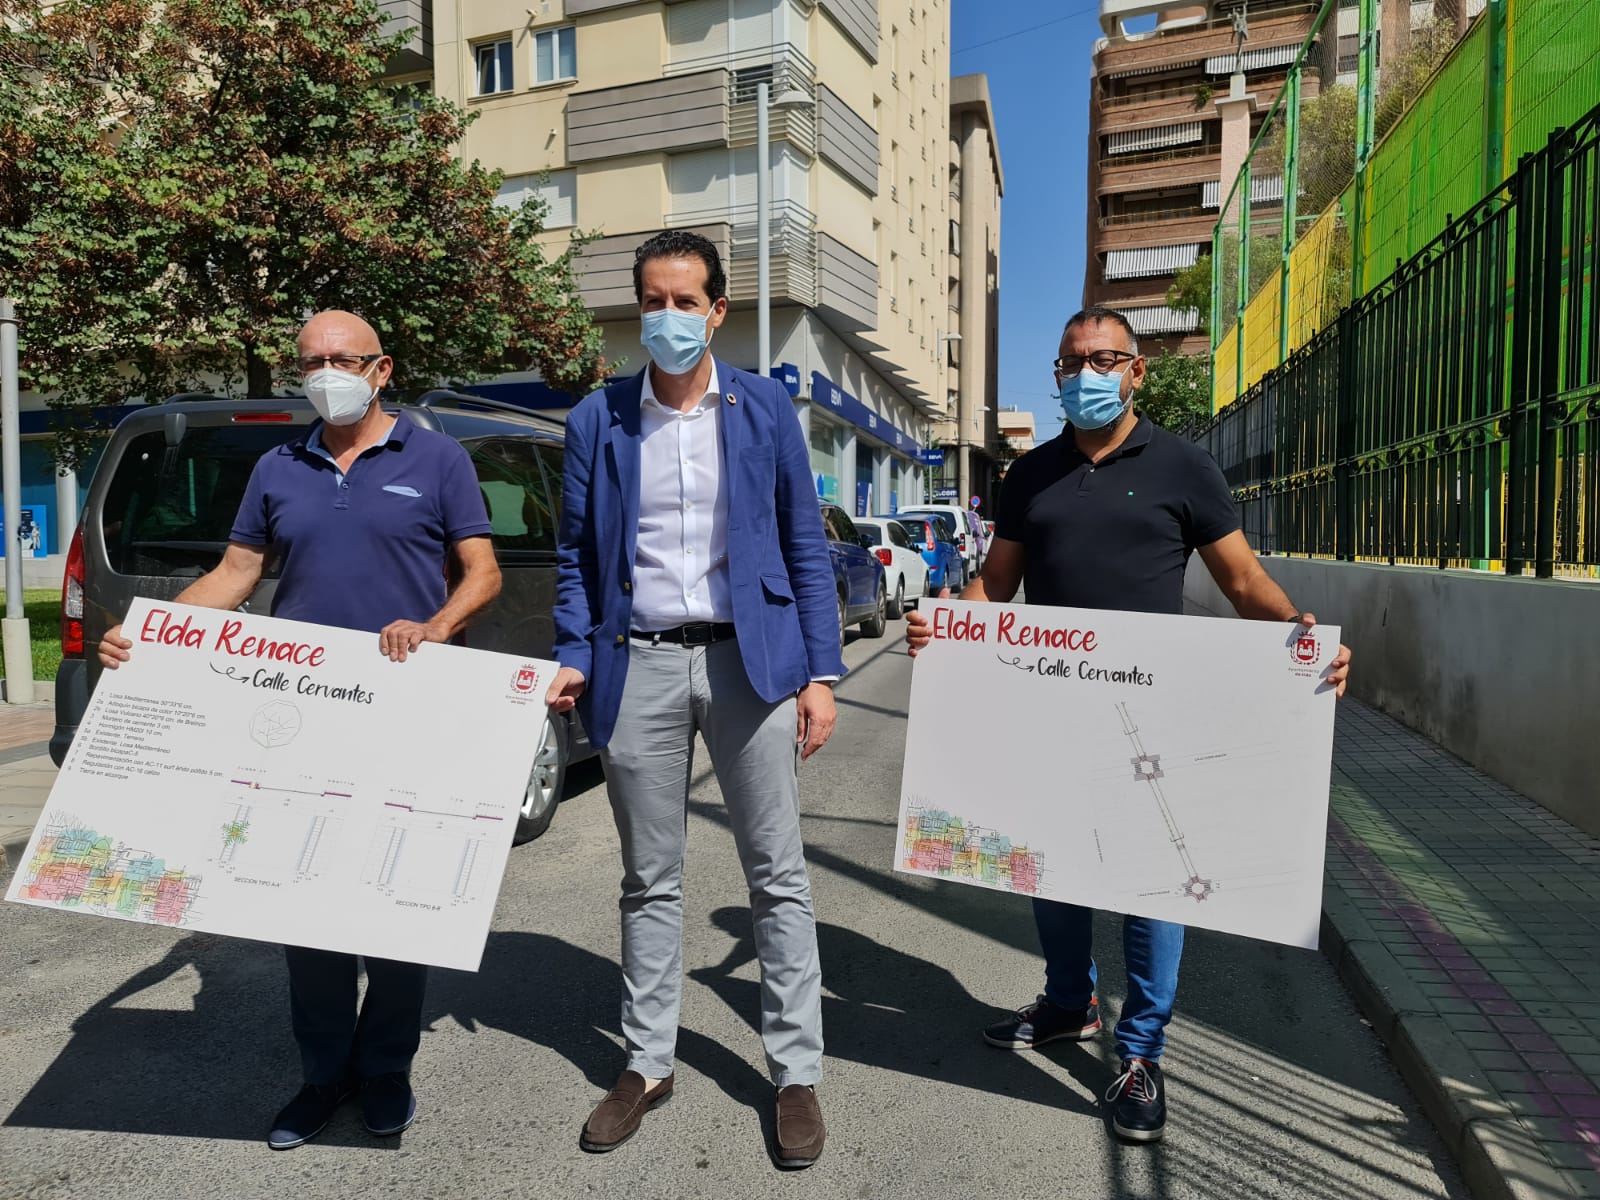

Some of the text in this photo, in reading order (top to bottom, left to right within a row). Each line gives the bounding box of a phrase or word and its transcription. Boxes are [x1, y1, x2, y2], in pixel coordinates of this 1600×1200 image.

[831, 387, 842, 407] BBVA
[140, 608, 326, 668] Elda Renace
[933, 607, 1098, 652] Elda Renace
[252, 668, 375, 705] Calle Cervantes
[1037, 656, 1154, 686] Calle Cervantes
